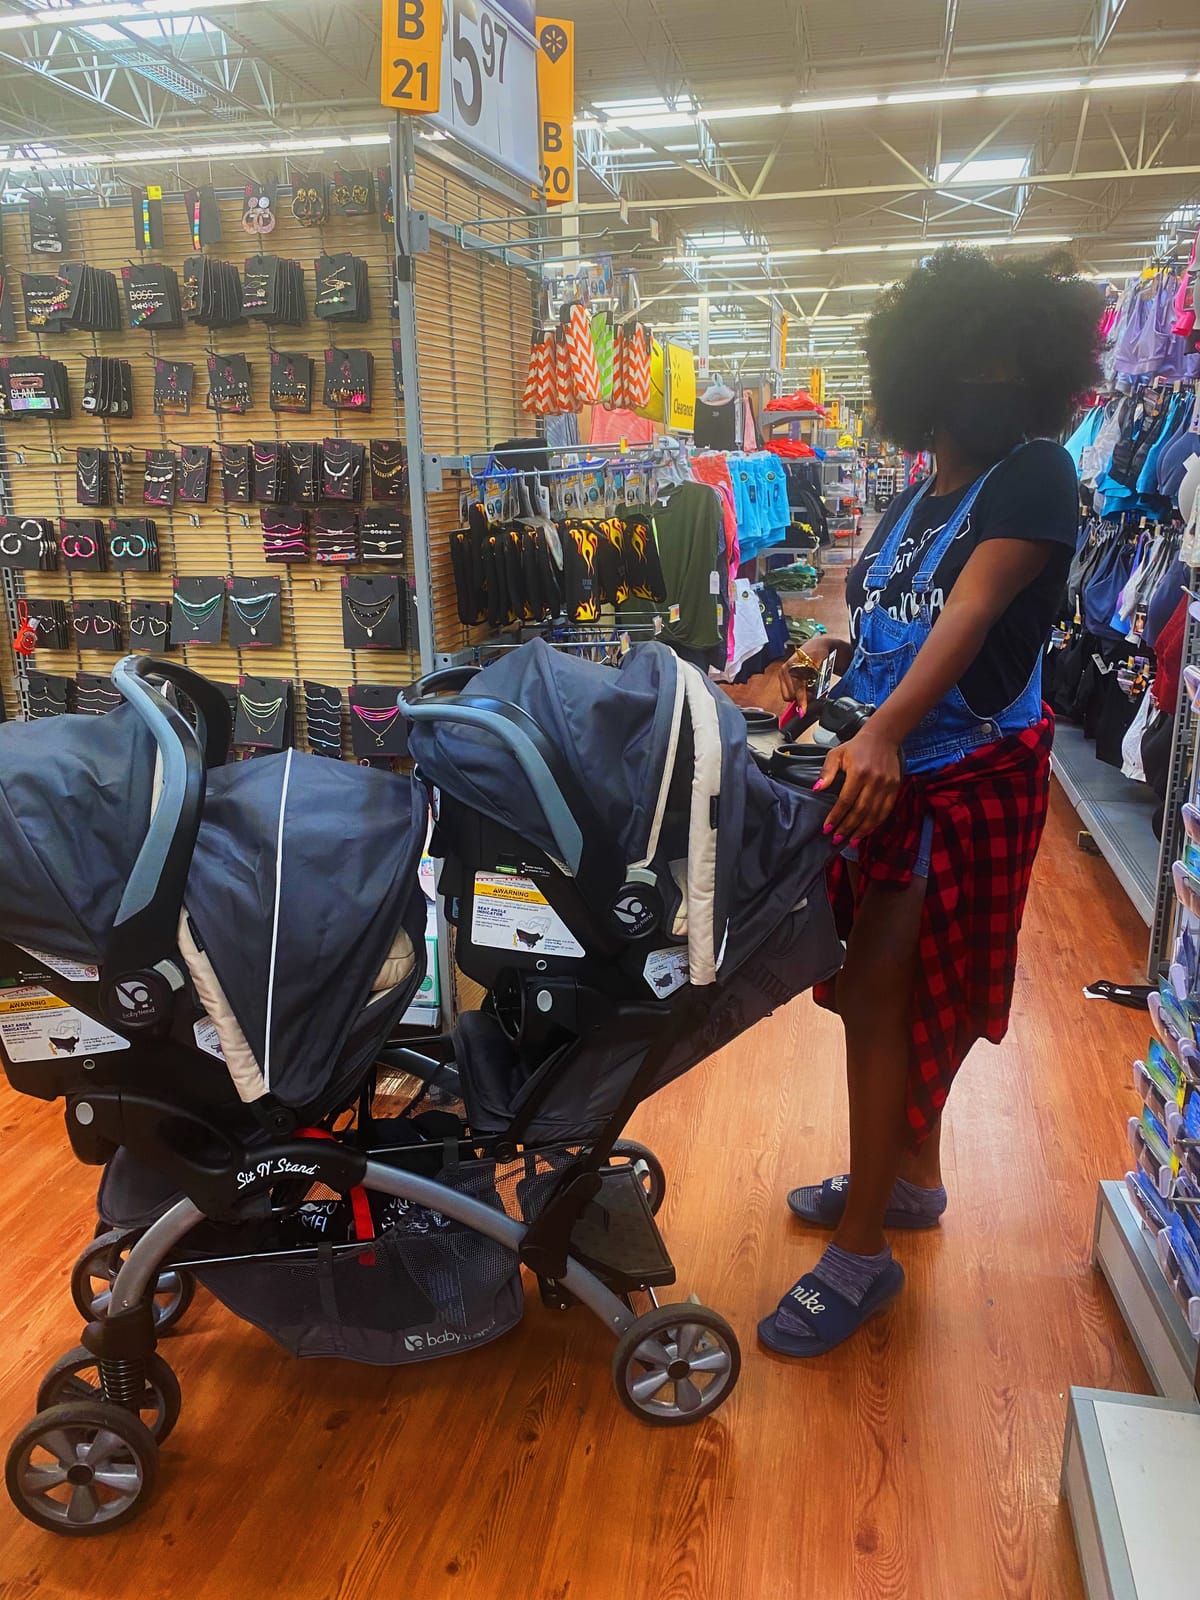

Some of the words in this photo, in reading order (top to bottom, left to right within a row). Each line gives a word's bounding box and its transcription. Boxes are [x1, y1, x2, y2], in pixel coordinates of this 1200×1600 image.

[397, 0, 425, 40] B
[391, 58, 428, 101] 21
[543, 121, 562, 153] B
[129, 289, 153, 301] BOSS
[673, 398, 694, 417] Clearance
[497, 888, 529, 898] WARNING
[14, 999, 47, 1009] WARNING
[236, 1171, 256, 1190] Sit
[273, 1157, 318, 1175] Stand
[790, 1285, 826, 1314] nike
